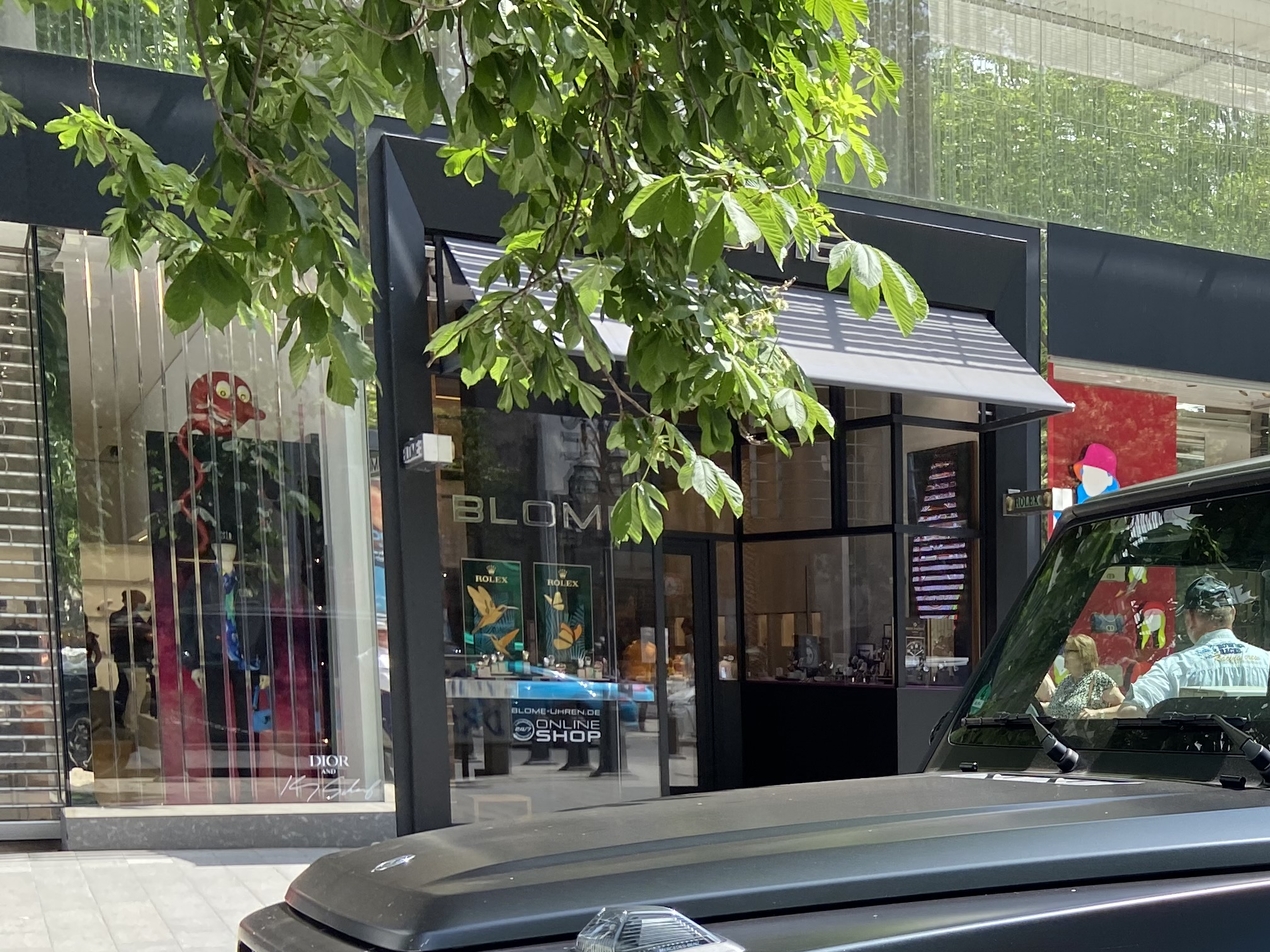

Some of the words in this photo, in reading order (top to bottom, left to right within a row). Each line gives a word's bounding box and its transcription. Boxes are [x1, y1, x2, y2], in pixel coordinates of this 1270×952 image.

[452, 494, 615, 531] BLOM
[475, 574, 509, 584] ROLEX
[546, 578, 580, 588] ROLEX
[511, 707, 601, 716] BLOME-UHREN.DE
[536, 719, 601, 730] ONLINE
[536, 730, 602, 743] SHOP
[309, 754, 350, 767] DIOR
